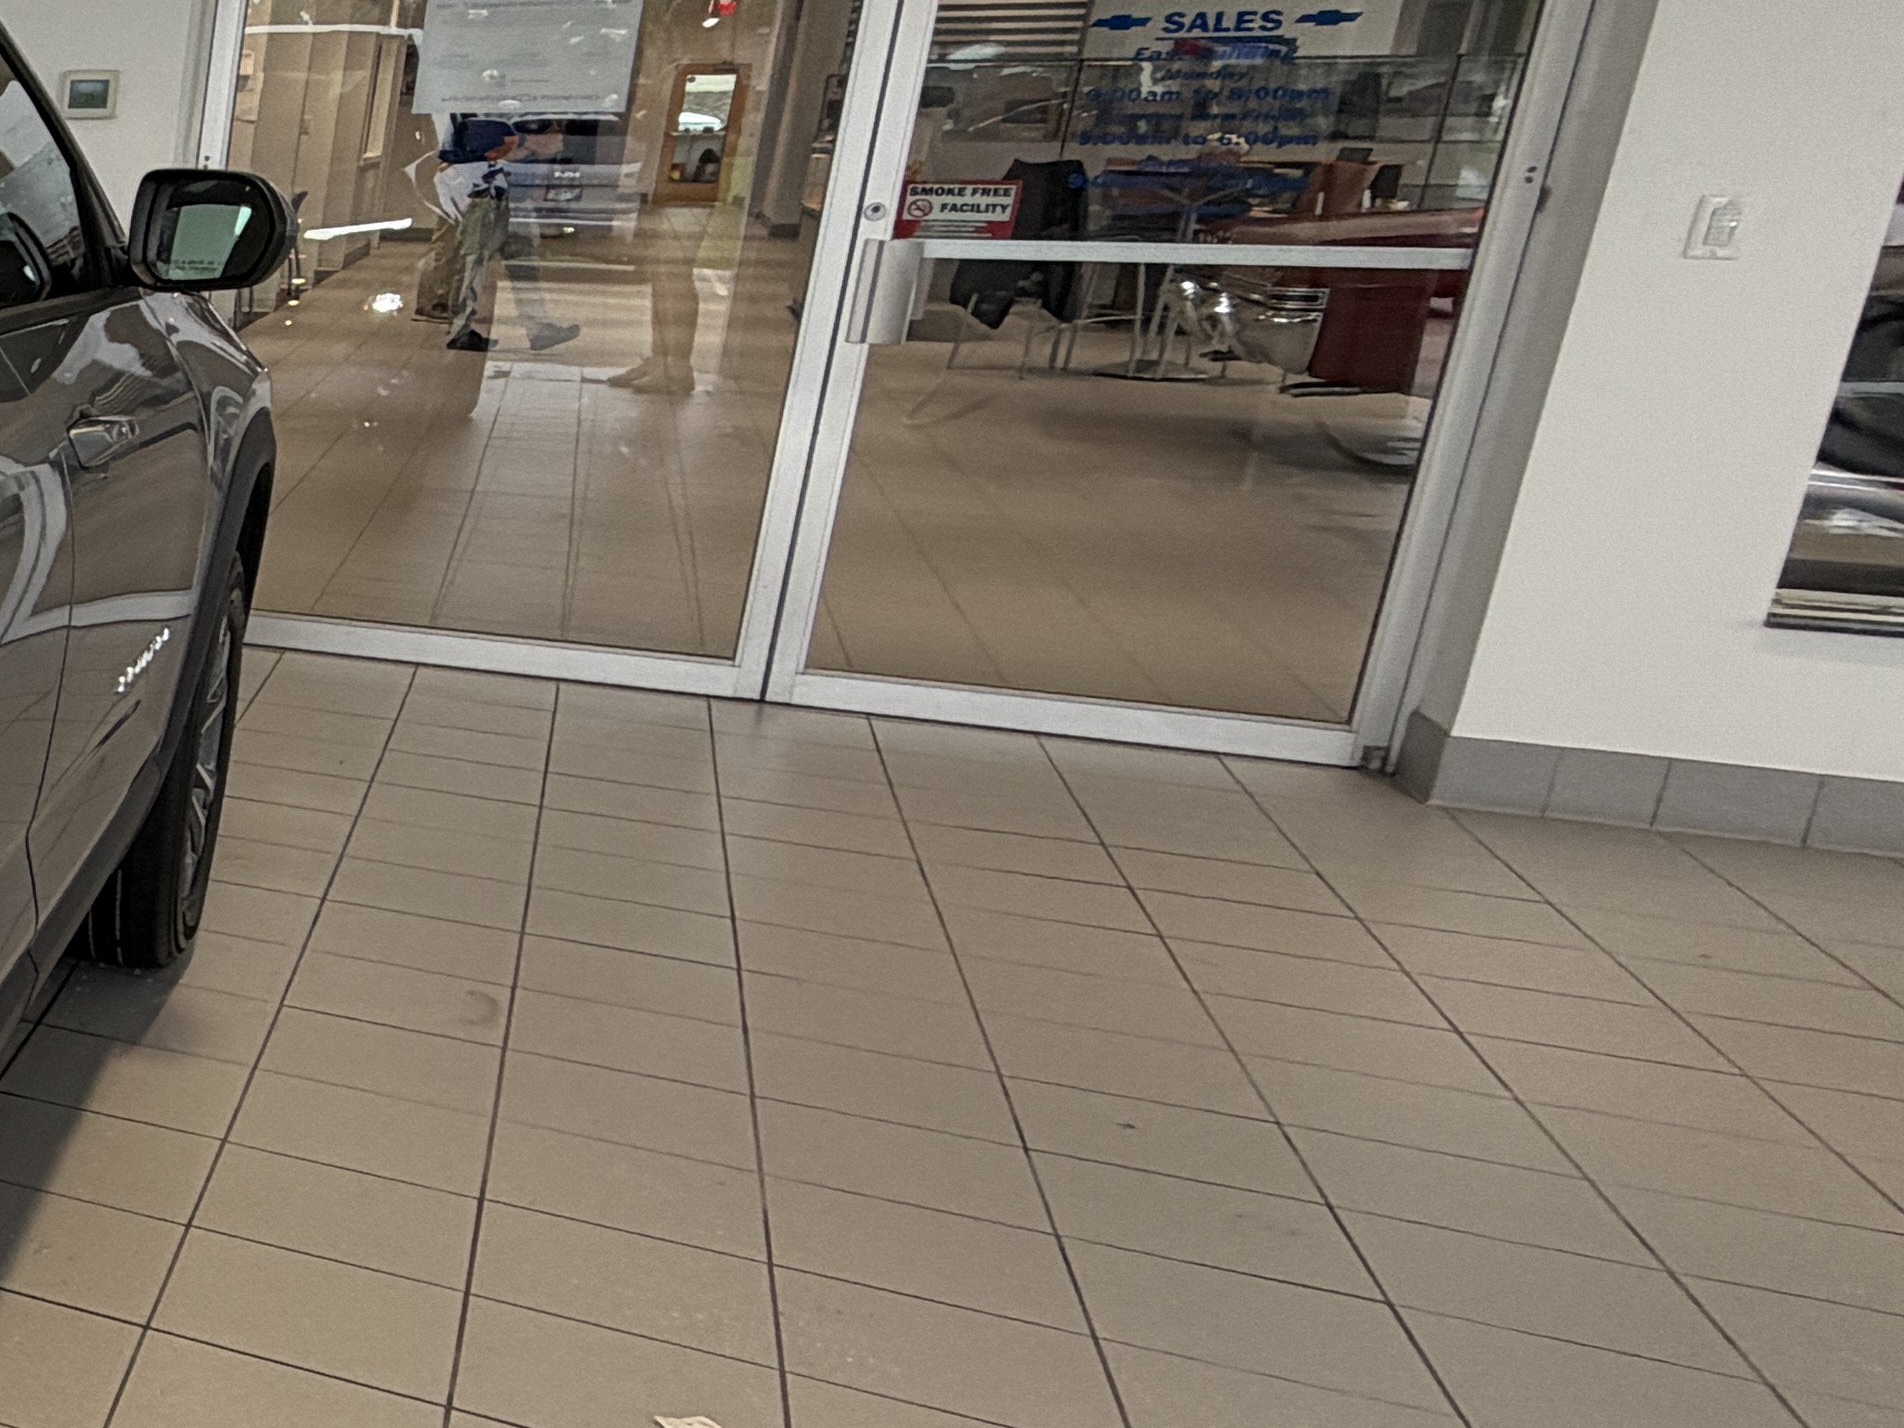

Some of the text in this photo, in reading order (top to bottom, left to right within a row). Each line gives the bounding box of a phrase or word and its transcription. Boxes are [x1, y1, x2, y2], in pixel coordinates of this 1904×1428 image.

[1161, 10, 1284, 34] SALES
[909, 186, 1013, 198] SMOKE FREE
[940, 203, 1010, 214] FACILITY
